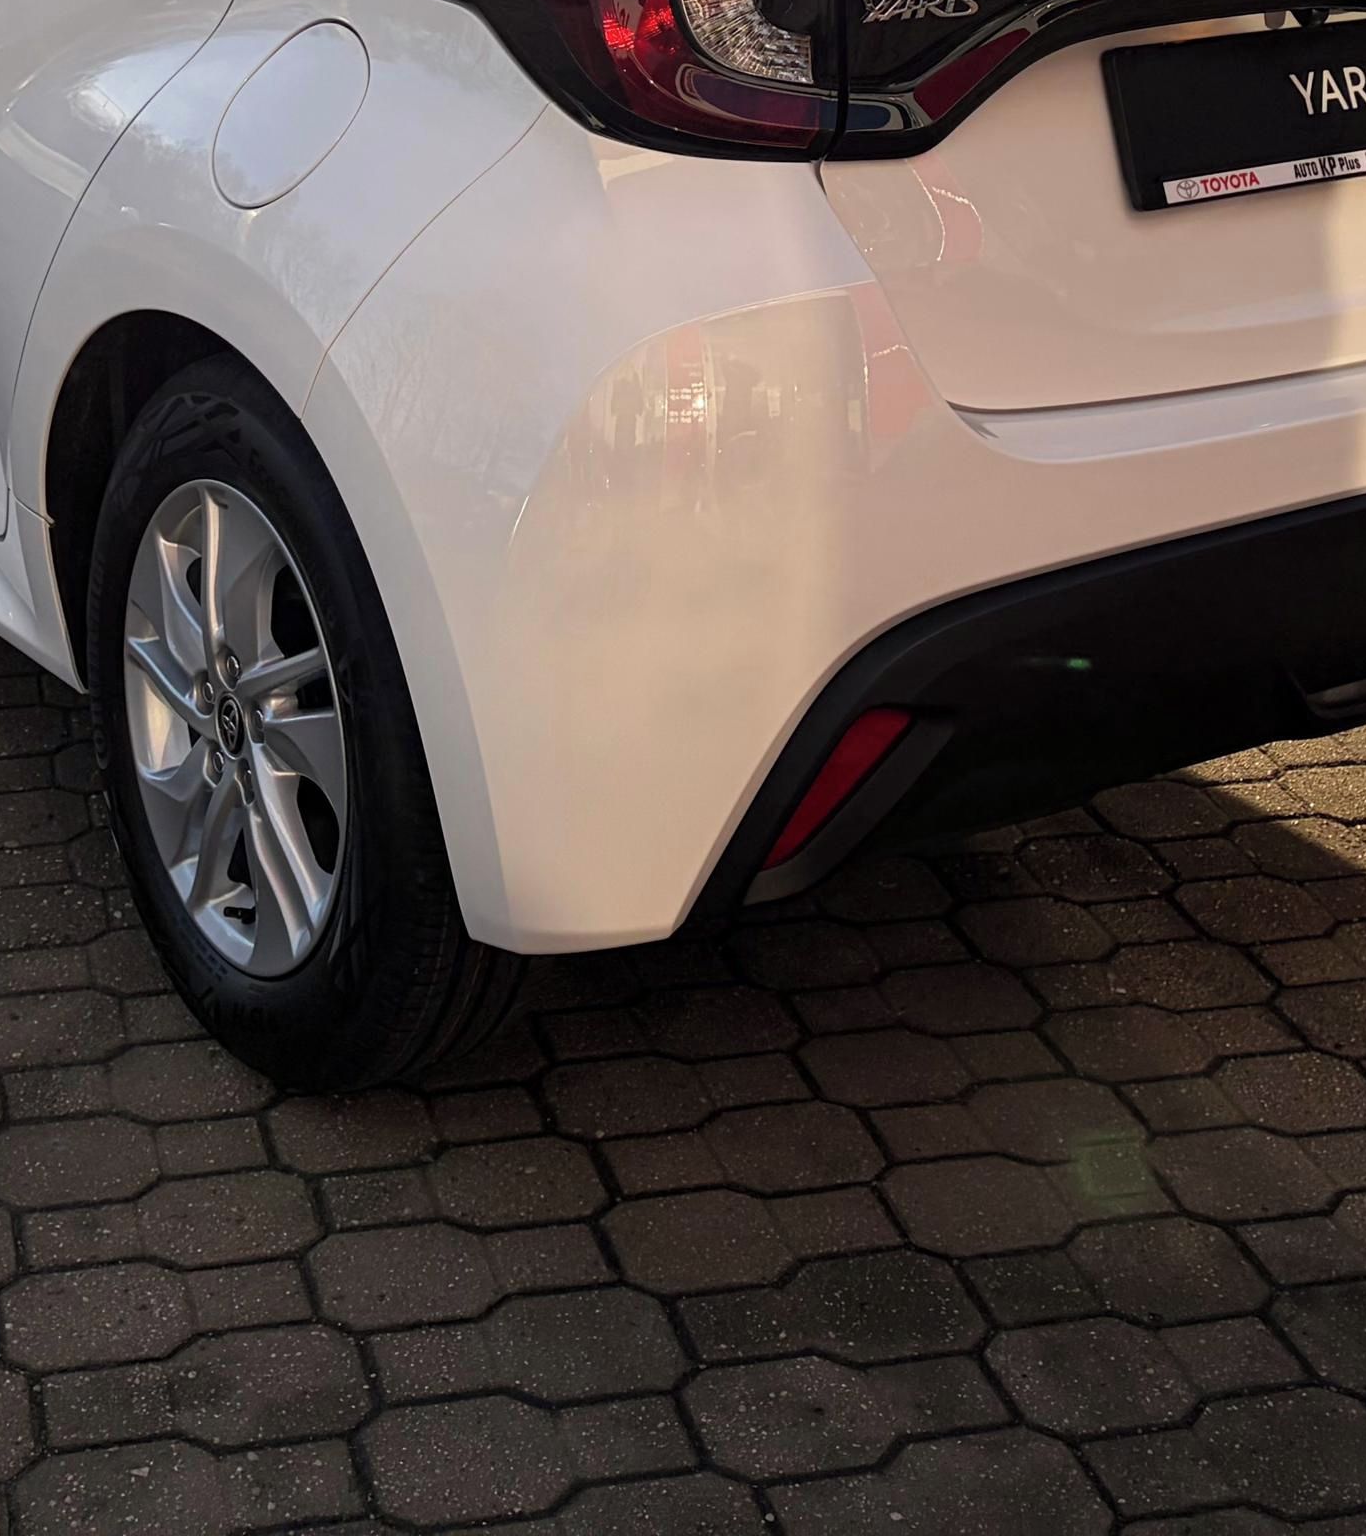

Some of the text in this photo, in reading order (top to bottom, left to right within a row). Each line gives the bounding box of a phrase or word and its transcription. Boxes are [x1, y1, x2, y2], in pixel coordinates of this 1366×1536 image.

[1294, 163, 1318, 179] AUTO
[1318, 156, 1336, 177] KP
[1337, 156, 1361, 172] Plus
[1200, 171, 1260, 194] TOYOTA
